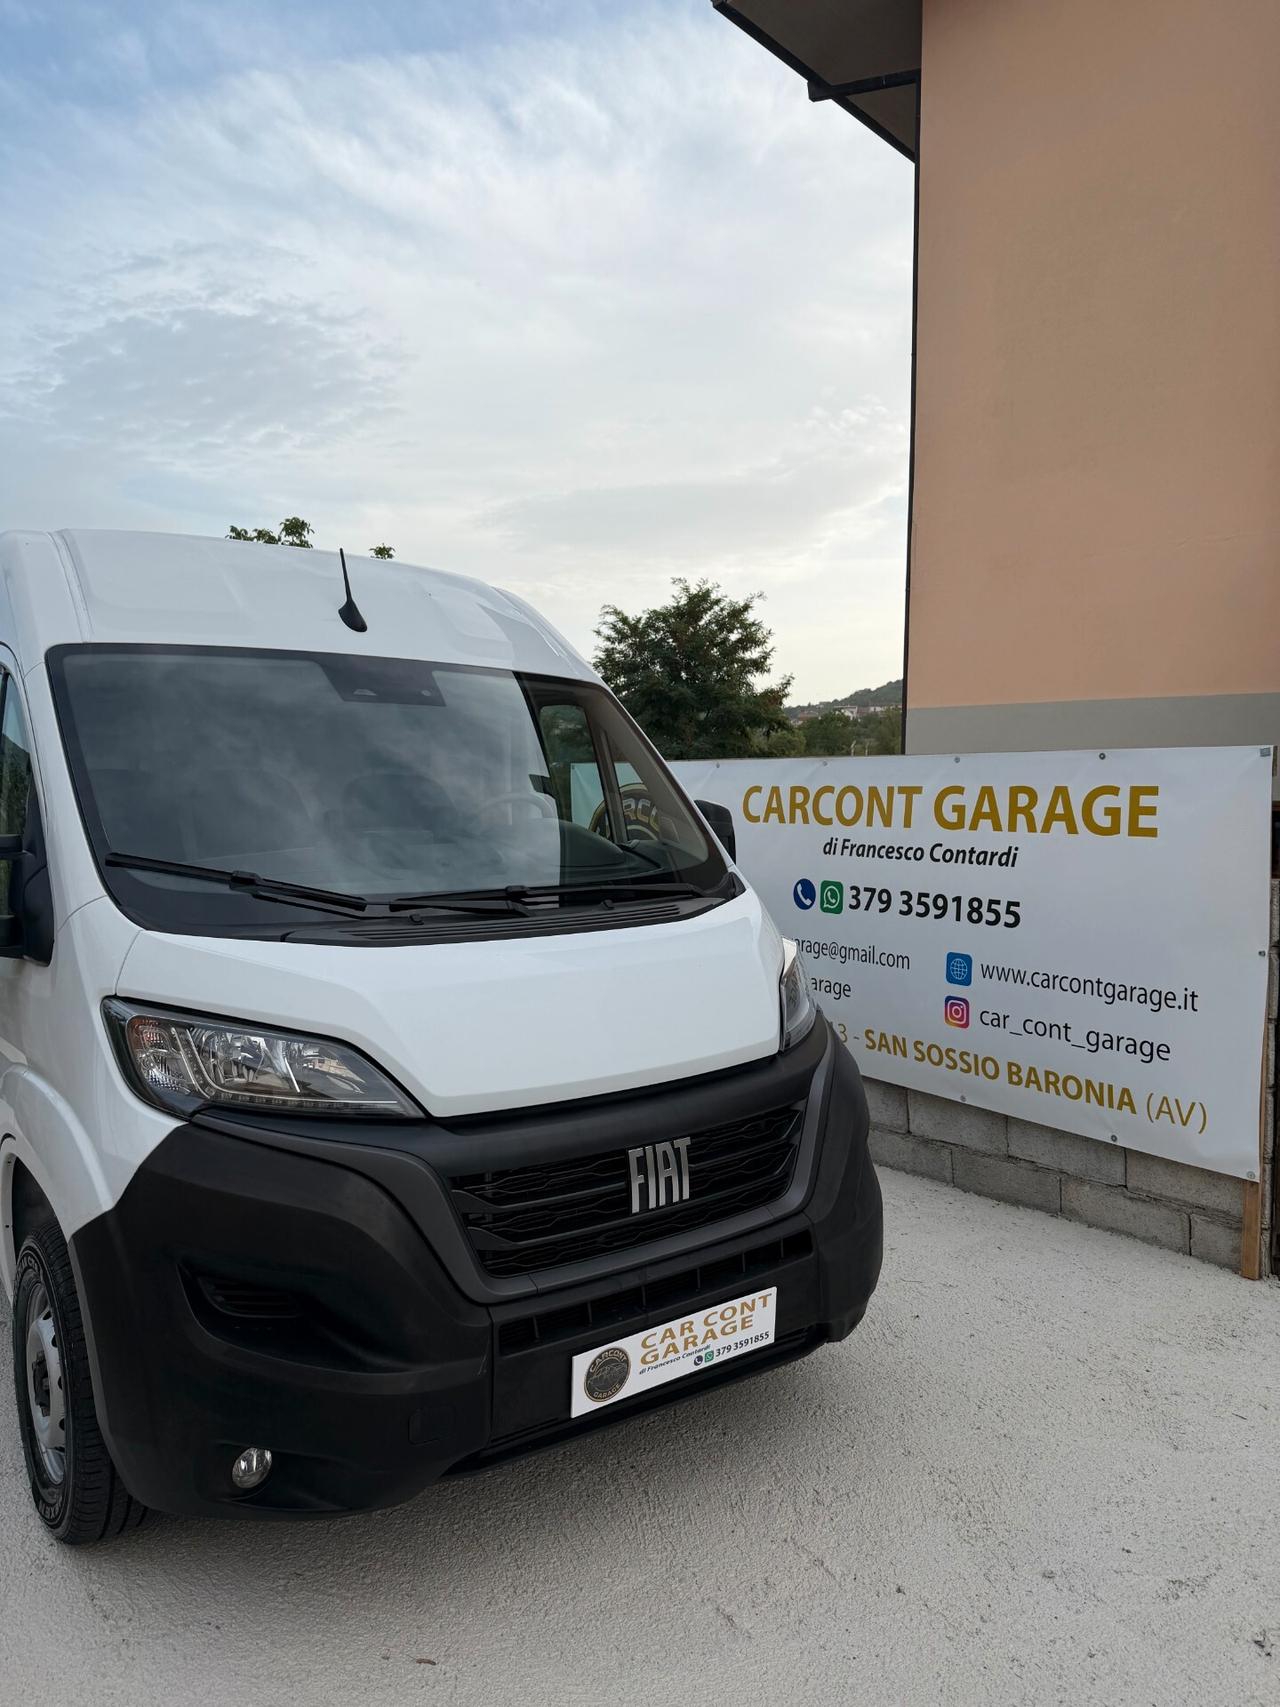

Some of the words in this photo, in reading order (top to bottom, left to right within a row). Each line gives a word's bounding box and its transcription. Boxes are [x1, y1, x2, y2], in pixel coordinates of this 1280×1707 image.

[742, 785, 922, 828] CARCONT
[933, 785, 1160, 838] GARAGE
[822, 837, 837, 856] di
[840, 839, 925, 862] Francesco
[929, 842, 1019, 868] Contardi
[848, 885, 892, 913] 379
[899, 889, 1021, 929] 3591855
[980, 961, 1199, 1013] www.carcontgarage.it
[979, 1007, 1171, 1063] car_cont_garage
[864, 1028, 908, 1059] SAN
[913, 1039, 1000, 1081] SOSSIO
[1007, 1061, 1137, 1115] BARONIA
[1146, 1092, 1208, 1134] (AV)
[628, 1136, 691, 1214] FIAT
[640, 1315, 754, 1366] GARAGE
[641, 1320, 694, 1350] CAR
[703, 1293, 772, 1328] CONT
[715, 1344, 732, 1357] 379
[732, 1330, 770, 1351] 3591855
[590, 1349, 627, 1374] CARCONT
[647, 1355, 681, 1373] Francesco
[593, 1383, 621, 1399] GARAGE
